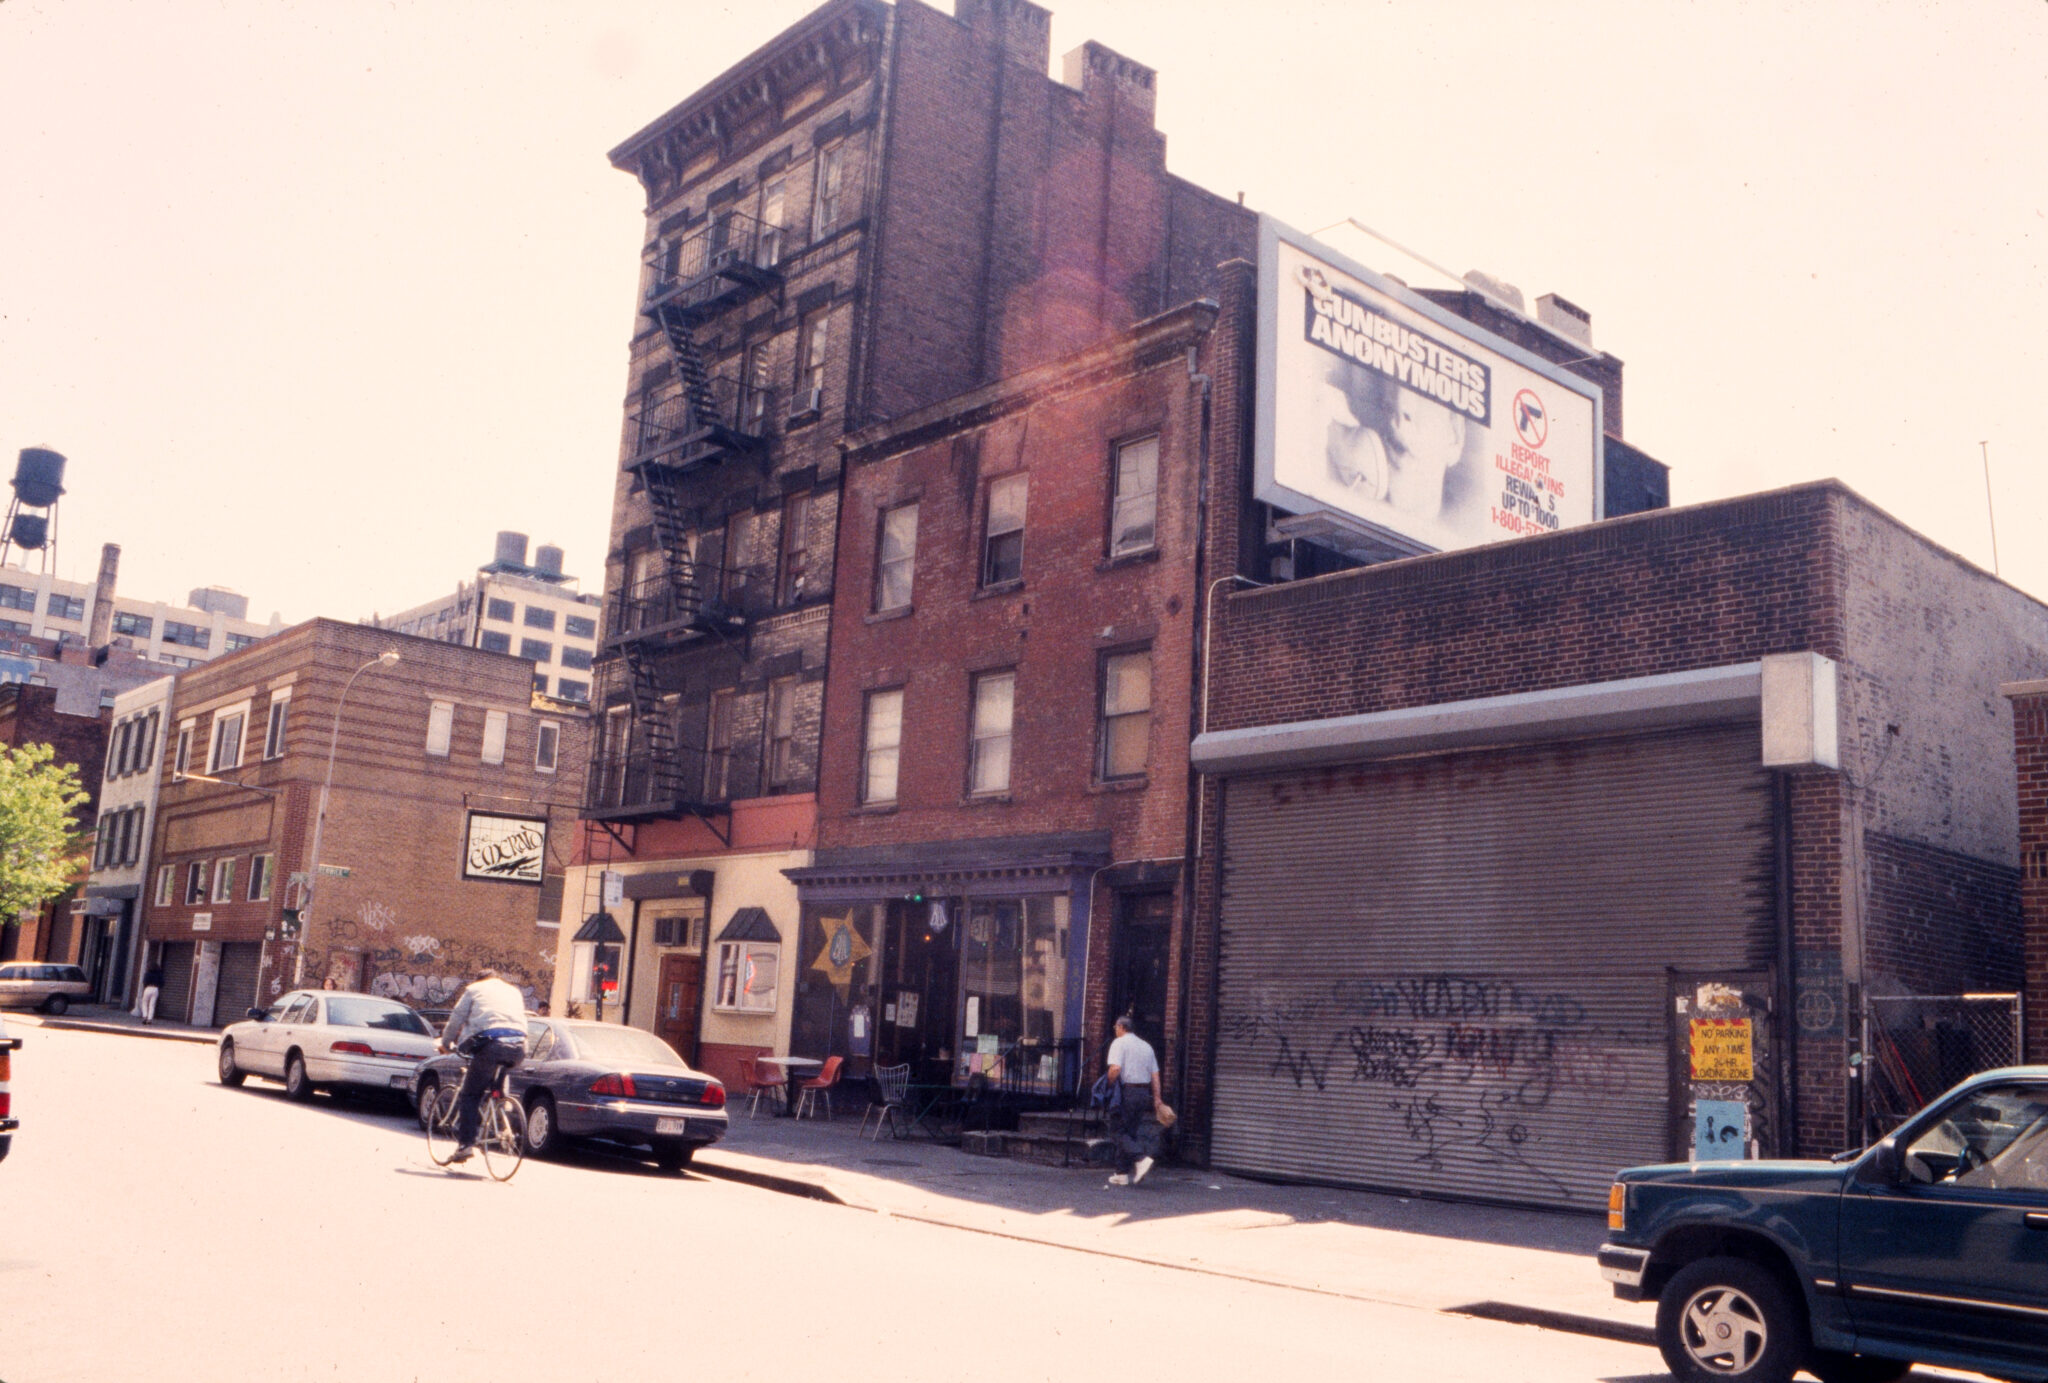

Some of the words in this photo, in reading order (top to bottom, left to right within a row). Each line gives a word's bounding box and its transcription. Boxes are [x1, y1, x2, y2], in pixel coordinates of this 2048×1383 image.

[1313, 292, 1486, 393] GUNBUSTERS
[1310, 312, 1486, 419] ANONYMOUS
[1511, 442, 1551, 474] REPORT
[1502, 491, 1516, 511] UP
[1517, 498, 1530, 519] TO
[1506, 474, 1555, 512] REWAS
[1701, 1028, 1712, 1039] NO
[1715, 1028, 1749, 1039] PARKING
[1703, 1044, 1719, 1055] ANY
[1726, 1043, 1746, 1055] TIME
[1729, 1067, 1750, 1079] ZONE
